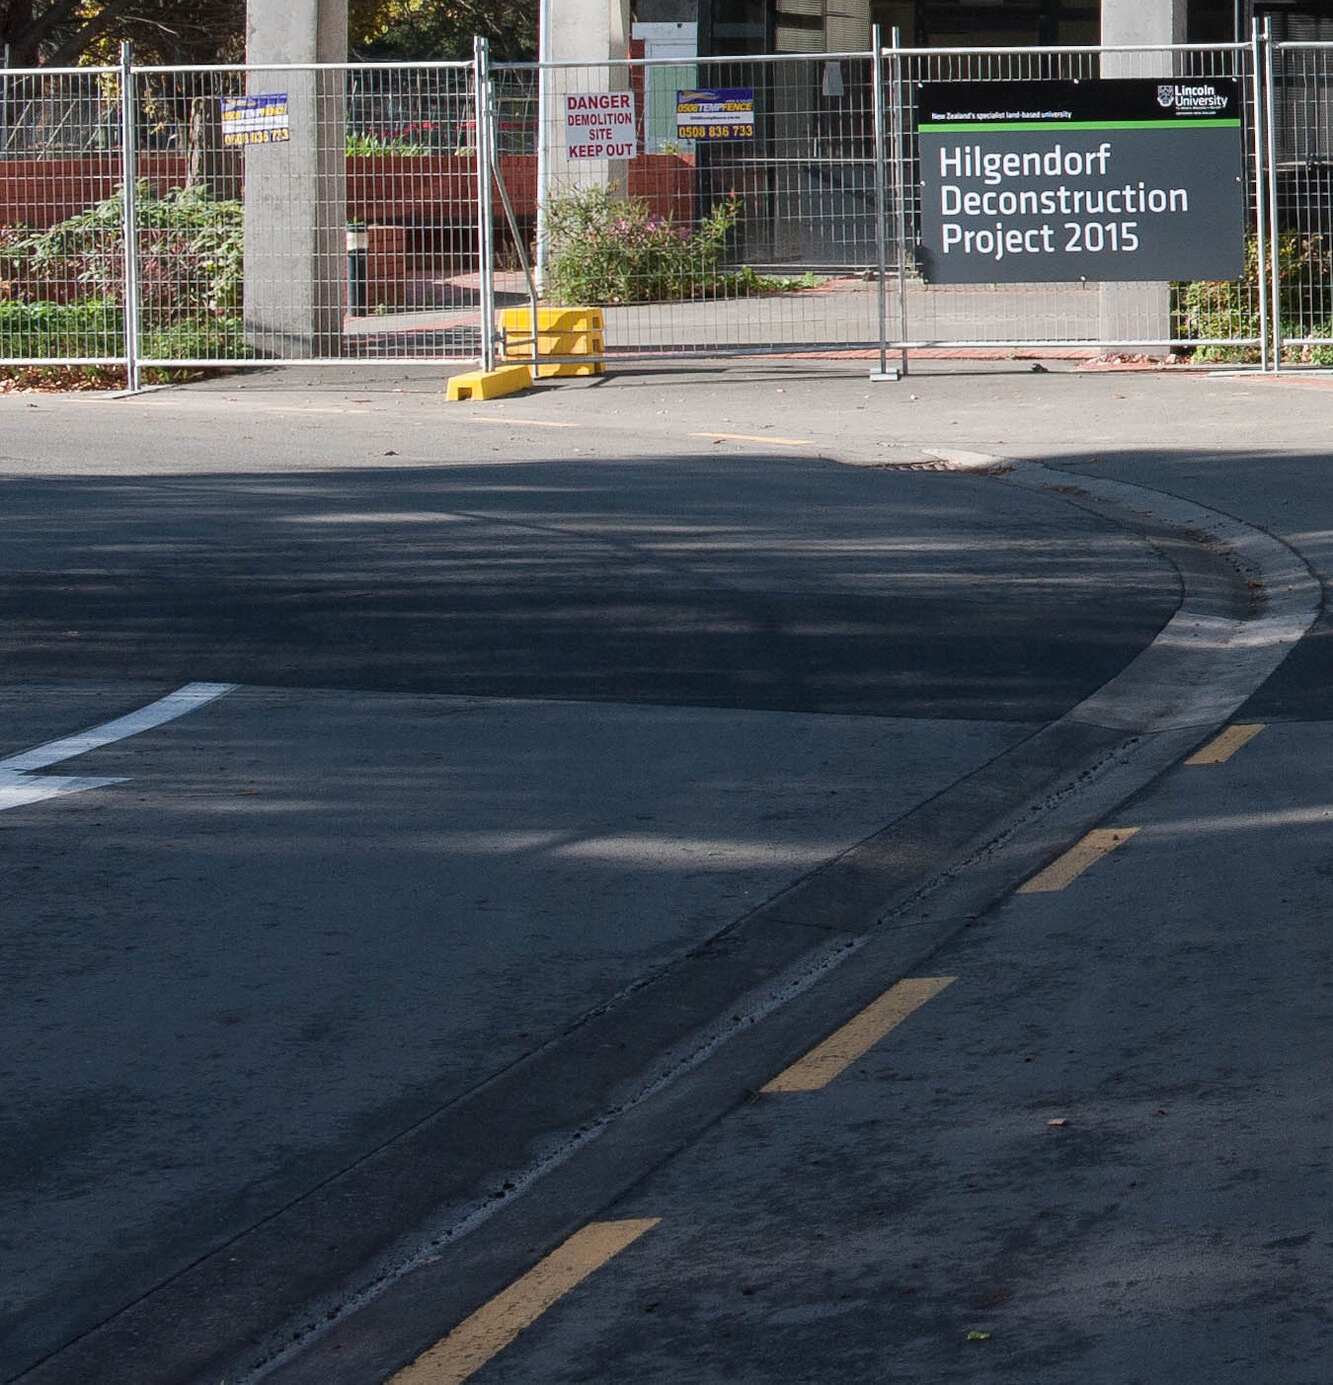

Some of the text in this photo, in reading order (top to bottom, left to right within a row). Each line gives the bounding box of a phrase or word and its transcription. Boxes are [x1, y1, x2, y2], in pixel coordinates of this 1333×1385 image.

[1175, 84, 1215, 95] Lincoln
[567, 95, 631, 110] DANGER
[1175, 95, 1228, 108] University
[567, 112, 632, 126] DEMOLITION
[931, 112, 946, 120] New
[946, 112, 976, 120] Zealand's
[589, 128, 613, 140] SITE
[679, 124, 753, 138] 0508 836 733
[569, 143, 633, 158] KEEP OUT
[939, 142, 1113, 185] Hilgendorf
[940, 181, 1189, 216] Deconstruction
[942, 221, 1140, 260] Project 2015
